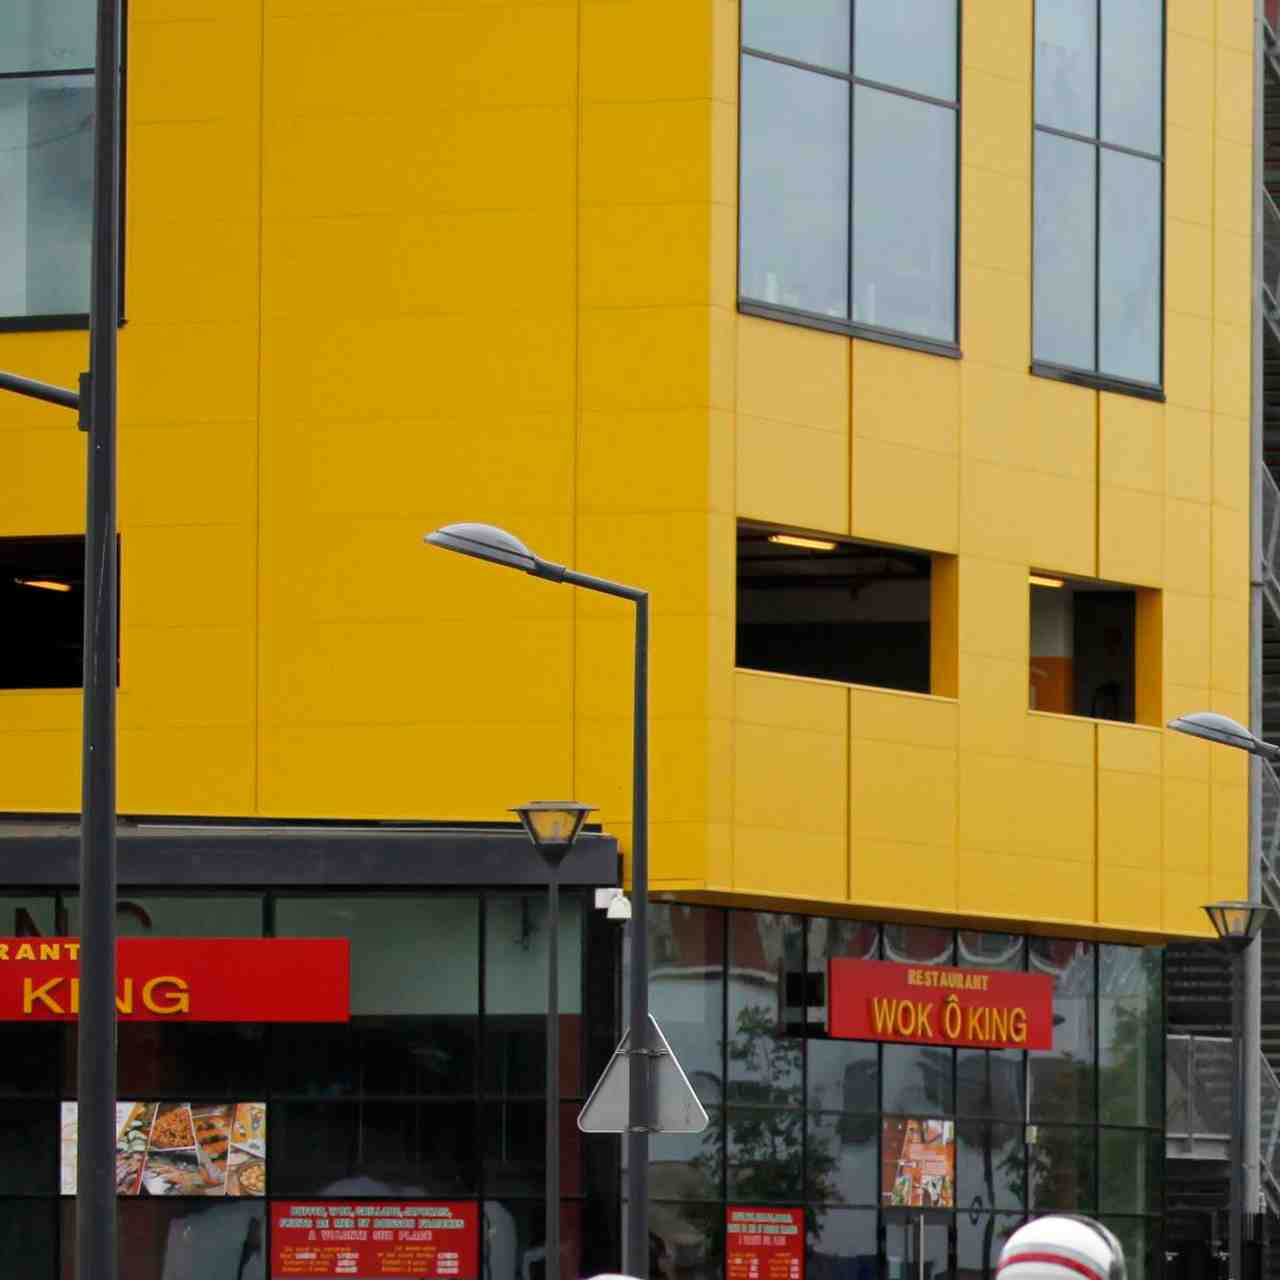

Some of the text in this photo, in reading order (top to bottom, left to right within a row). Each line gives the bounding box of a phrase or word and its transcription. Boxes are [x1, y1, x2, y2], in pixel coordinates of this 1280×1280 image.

[907, 969, 990, 991] RESTAURANT
[872, 993, 1029, 1043] WOK Ô KING
